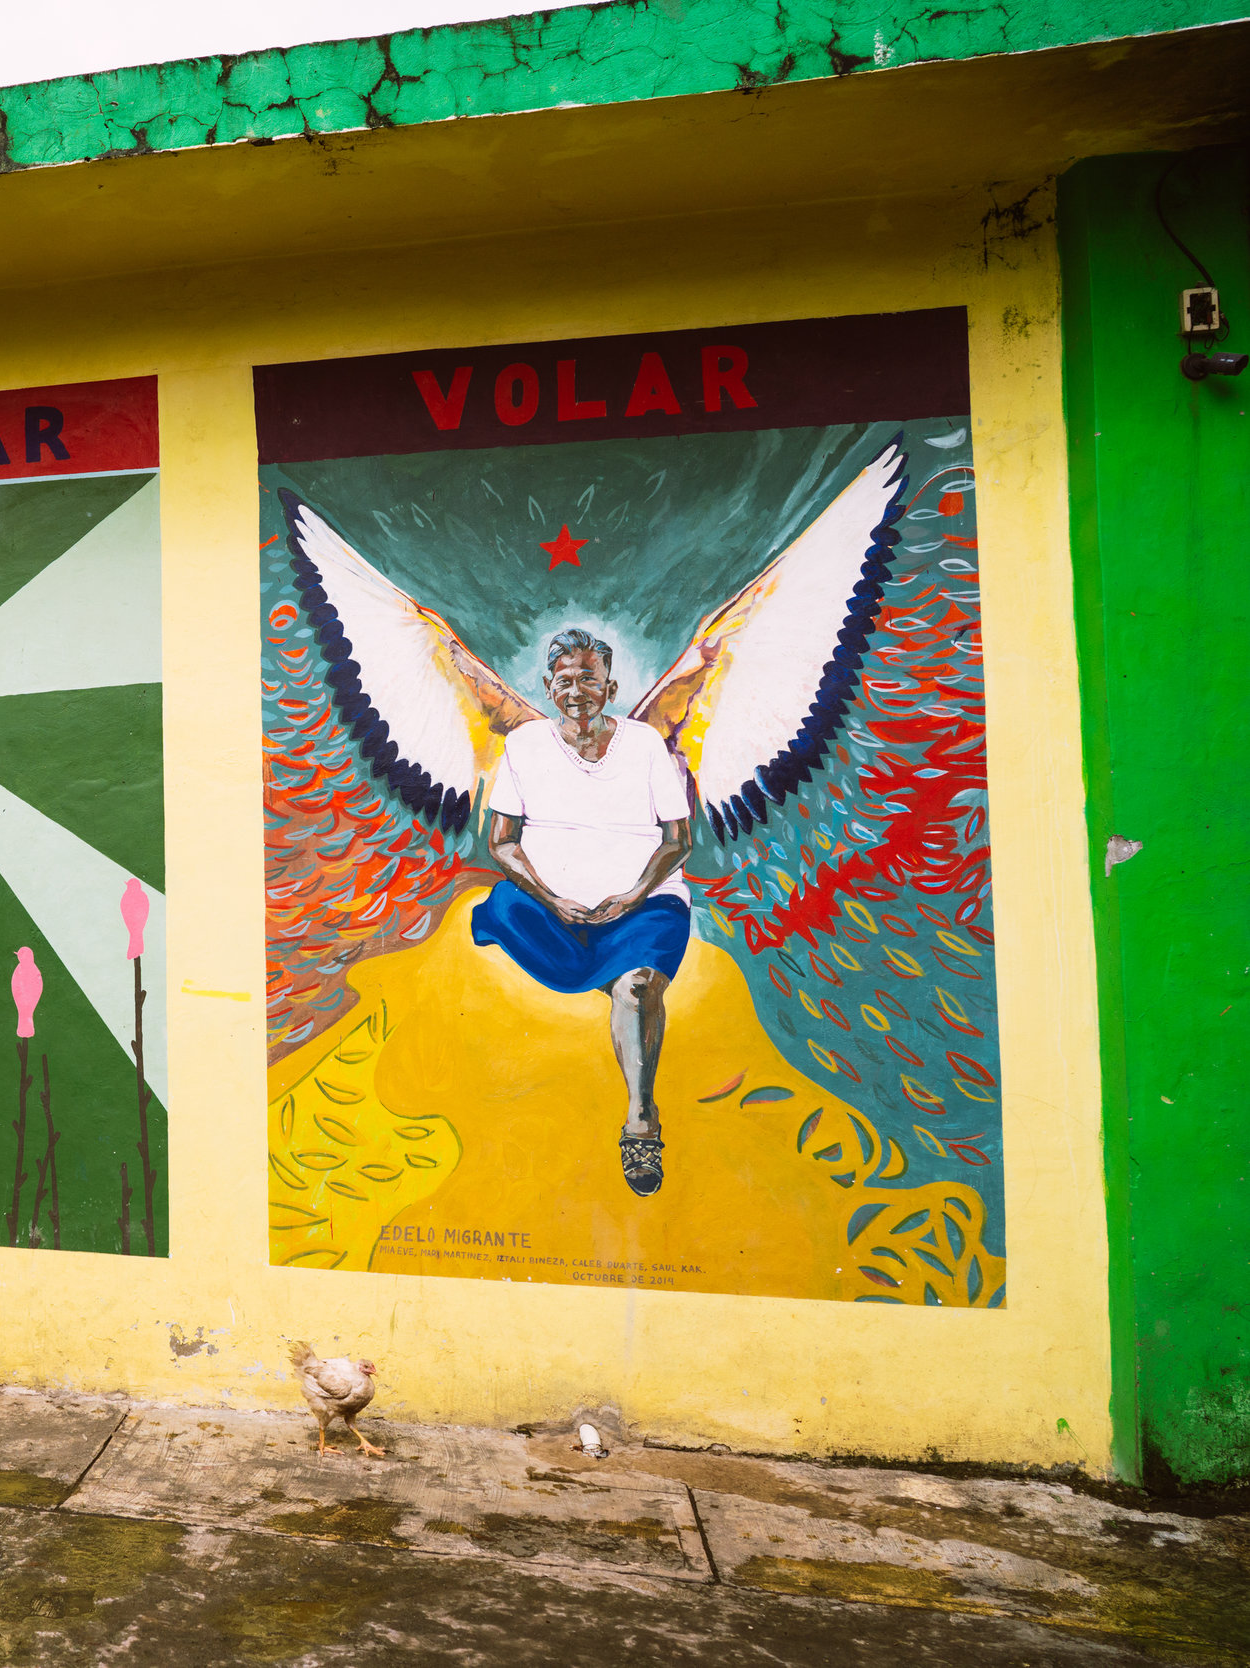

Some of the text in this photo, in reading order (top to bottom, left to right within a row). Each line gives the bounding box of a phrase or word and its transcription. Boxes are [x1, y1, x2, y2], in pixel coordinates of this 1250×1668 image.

[412, 344, 759, 431] VOLAR
[379, 1225, 532, 1249] EDELO MIGRANTE
[443, 1250, 492, 1263] MARTINEZ,
[572, 1258, 603, 1269] CALEB
[652, 1263, 677, 1272] SAUL
[572, 1271, 675, 1286] OCTUBRE DE 2014
